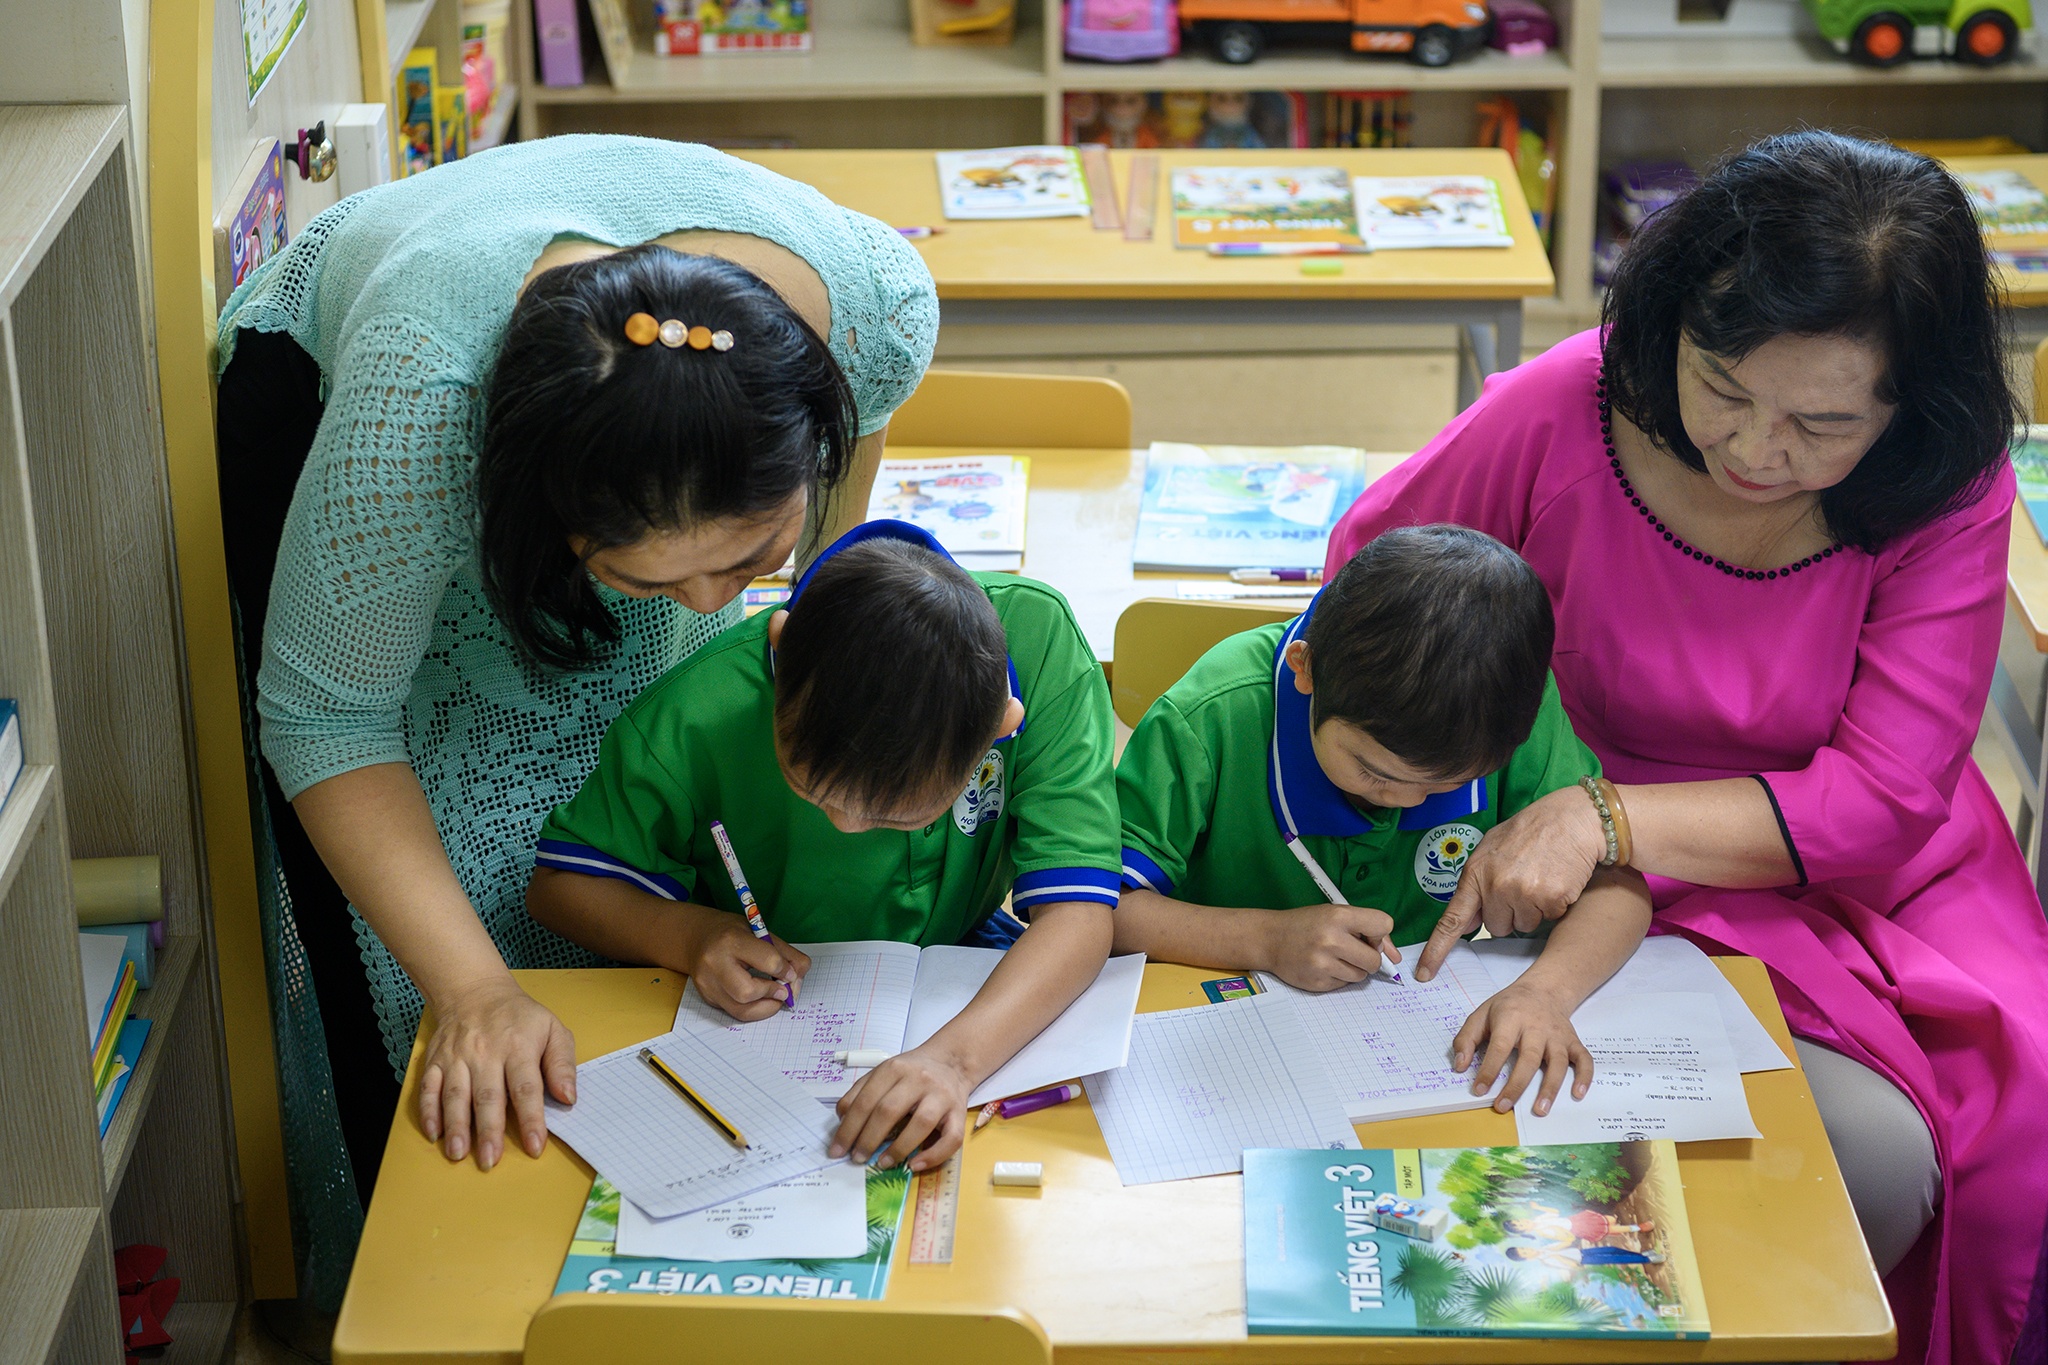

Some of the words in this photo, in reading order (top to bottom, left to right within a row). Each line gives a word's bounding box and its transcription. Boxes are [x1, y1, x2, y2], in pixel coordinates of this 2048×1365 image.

[1259, 529, 1327, 544] IẾNG
[1430, 829, 1447, 842] LỚP
[1450, 827, 1471, 837] HỌC
[1421, 875, 1437, 887] HOA
[1325, 1164, 1374, 1182] 3
[1403, 1166, 1412, 1178] MỘT
[1405, 1178, 1415, 1189] TẬP
[1333, 1186, 1378, 1237] VIỆT
[587, 1268, 623, 1294] 3
[628, 1267, 722, 1296] VIỆT
[1336, 1240, 1384, 1312] TIẾNG
